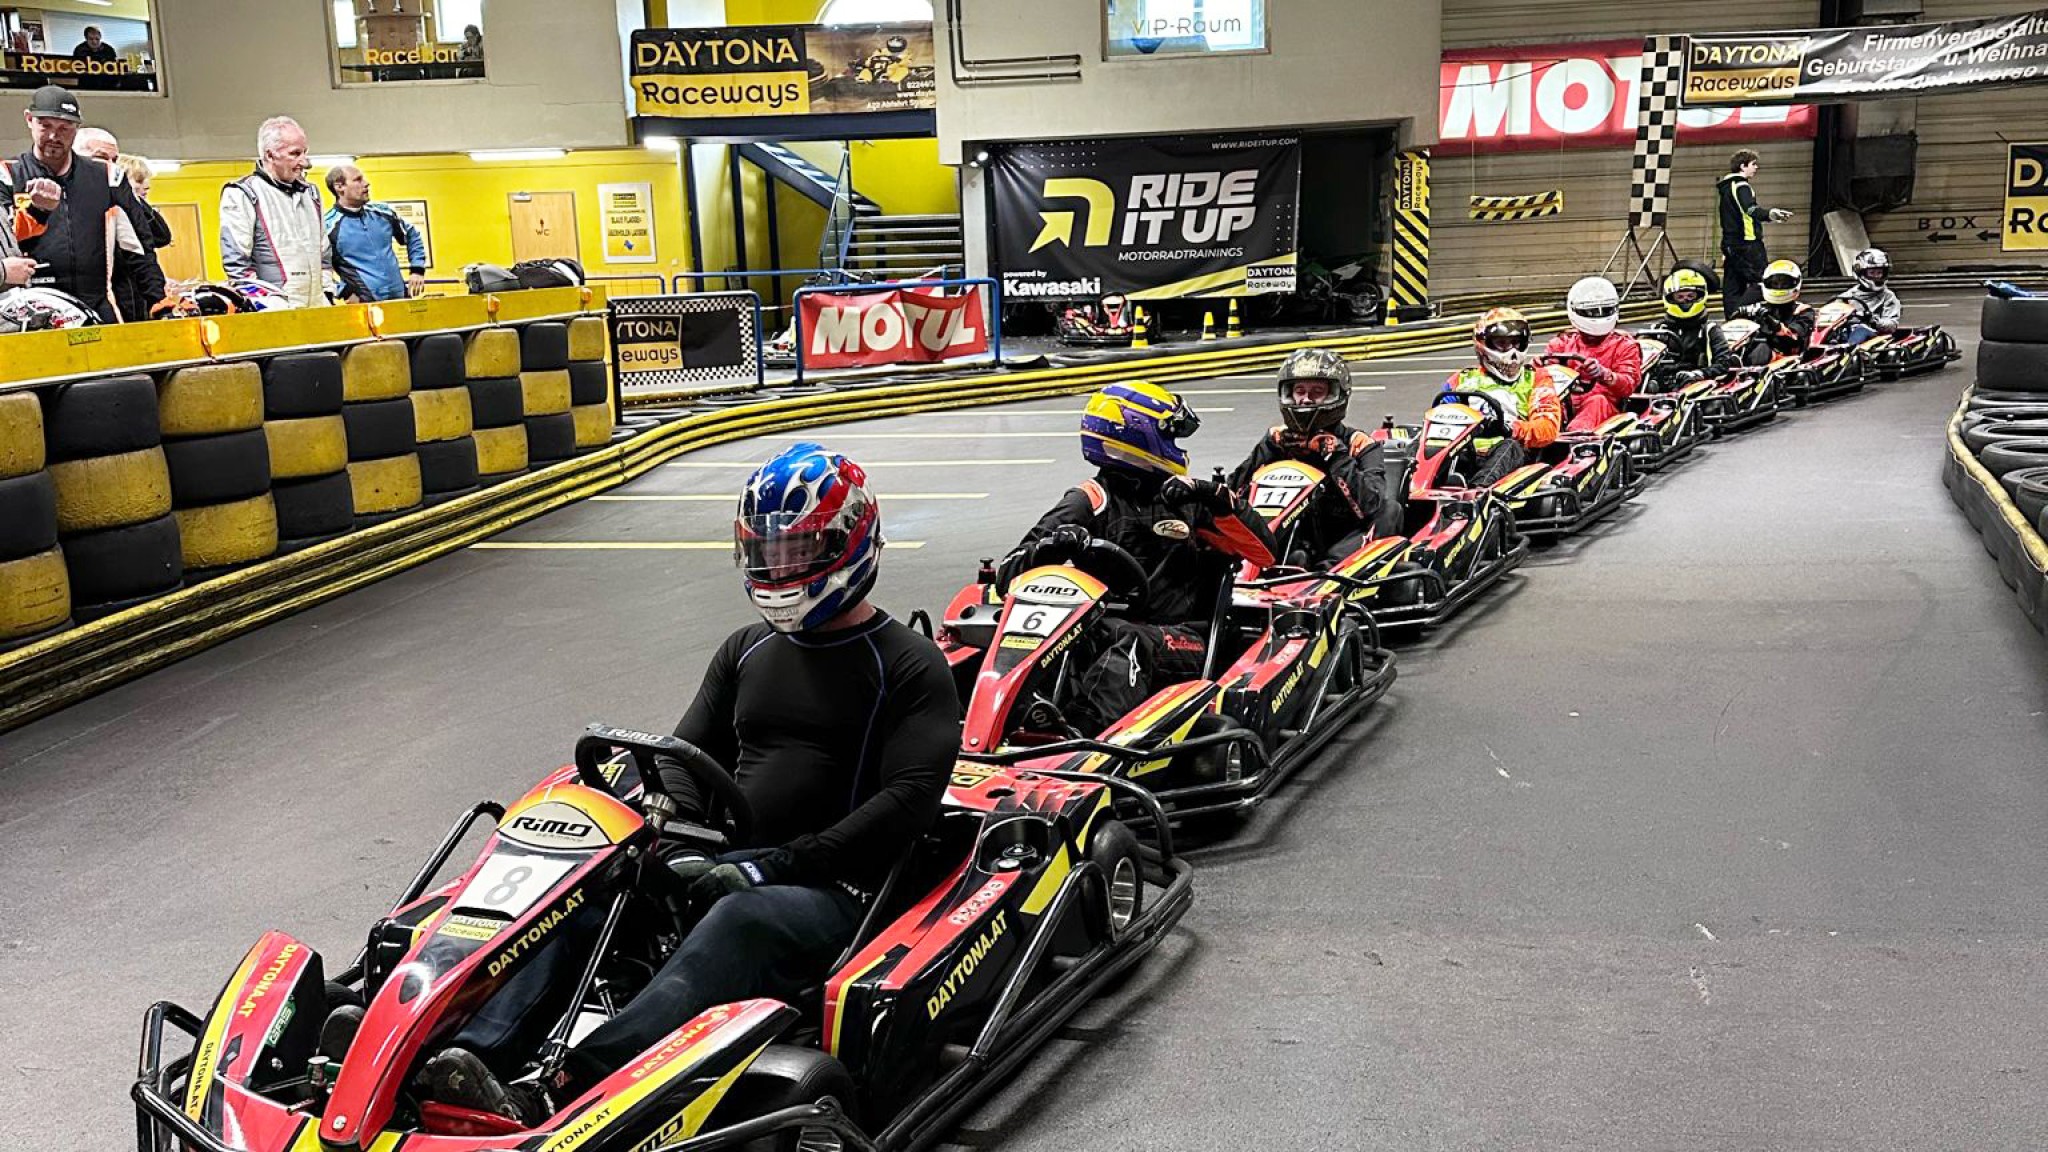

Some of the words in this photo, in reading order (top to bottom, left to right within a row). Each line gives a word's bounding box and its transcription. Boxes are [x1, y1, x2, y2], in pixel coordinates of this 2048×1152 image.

[1132, 17, 1241, 36] VIP-Raum
[21, 55, 132, 75] Racebar
[365, 47, 458, 65] Racebar
[637, 38, 800, 67] DAYTONA
[1694, 45, 1800, 65] DAYTONA
[641, 81, 799, 108] Raceways
[1212, 138, 1298, 149] WWW.RIDEITUP.COM
[1402, 162, 1411, 209] DAYTONA
[2013, 158, 2048, 187] D
[1127, 170, 1259, 209] RIDE
[1121, 209, 1175, 245] IT
[1181, 206, 1257, 243] UP
[1118, 247, 1243, 261] MOTORRADTRAININGS
[1003, 270, 1036, 279] powered
[1037, 270, 1048, 278] by
[1247, 267, 1297, 277] DAYTONA
[1003, 277, 1100, 296] Kawasaki
[812, 302, 976, 355] MOTUL
[1264, 491, 1288, 504] 11
[1022, 611, 1047, 631] 6
[483, 866, 533, 905] 8
[488, 888, 586, 977] DAYTONA.AT
[926, 909, 1008, 1021] DAYTONA.AT
[238, 943, 299, 1020] DAYTONA.AT
[631, 1004, 731, 1079] DAYTONA.AT
